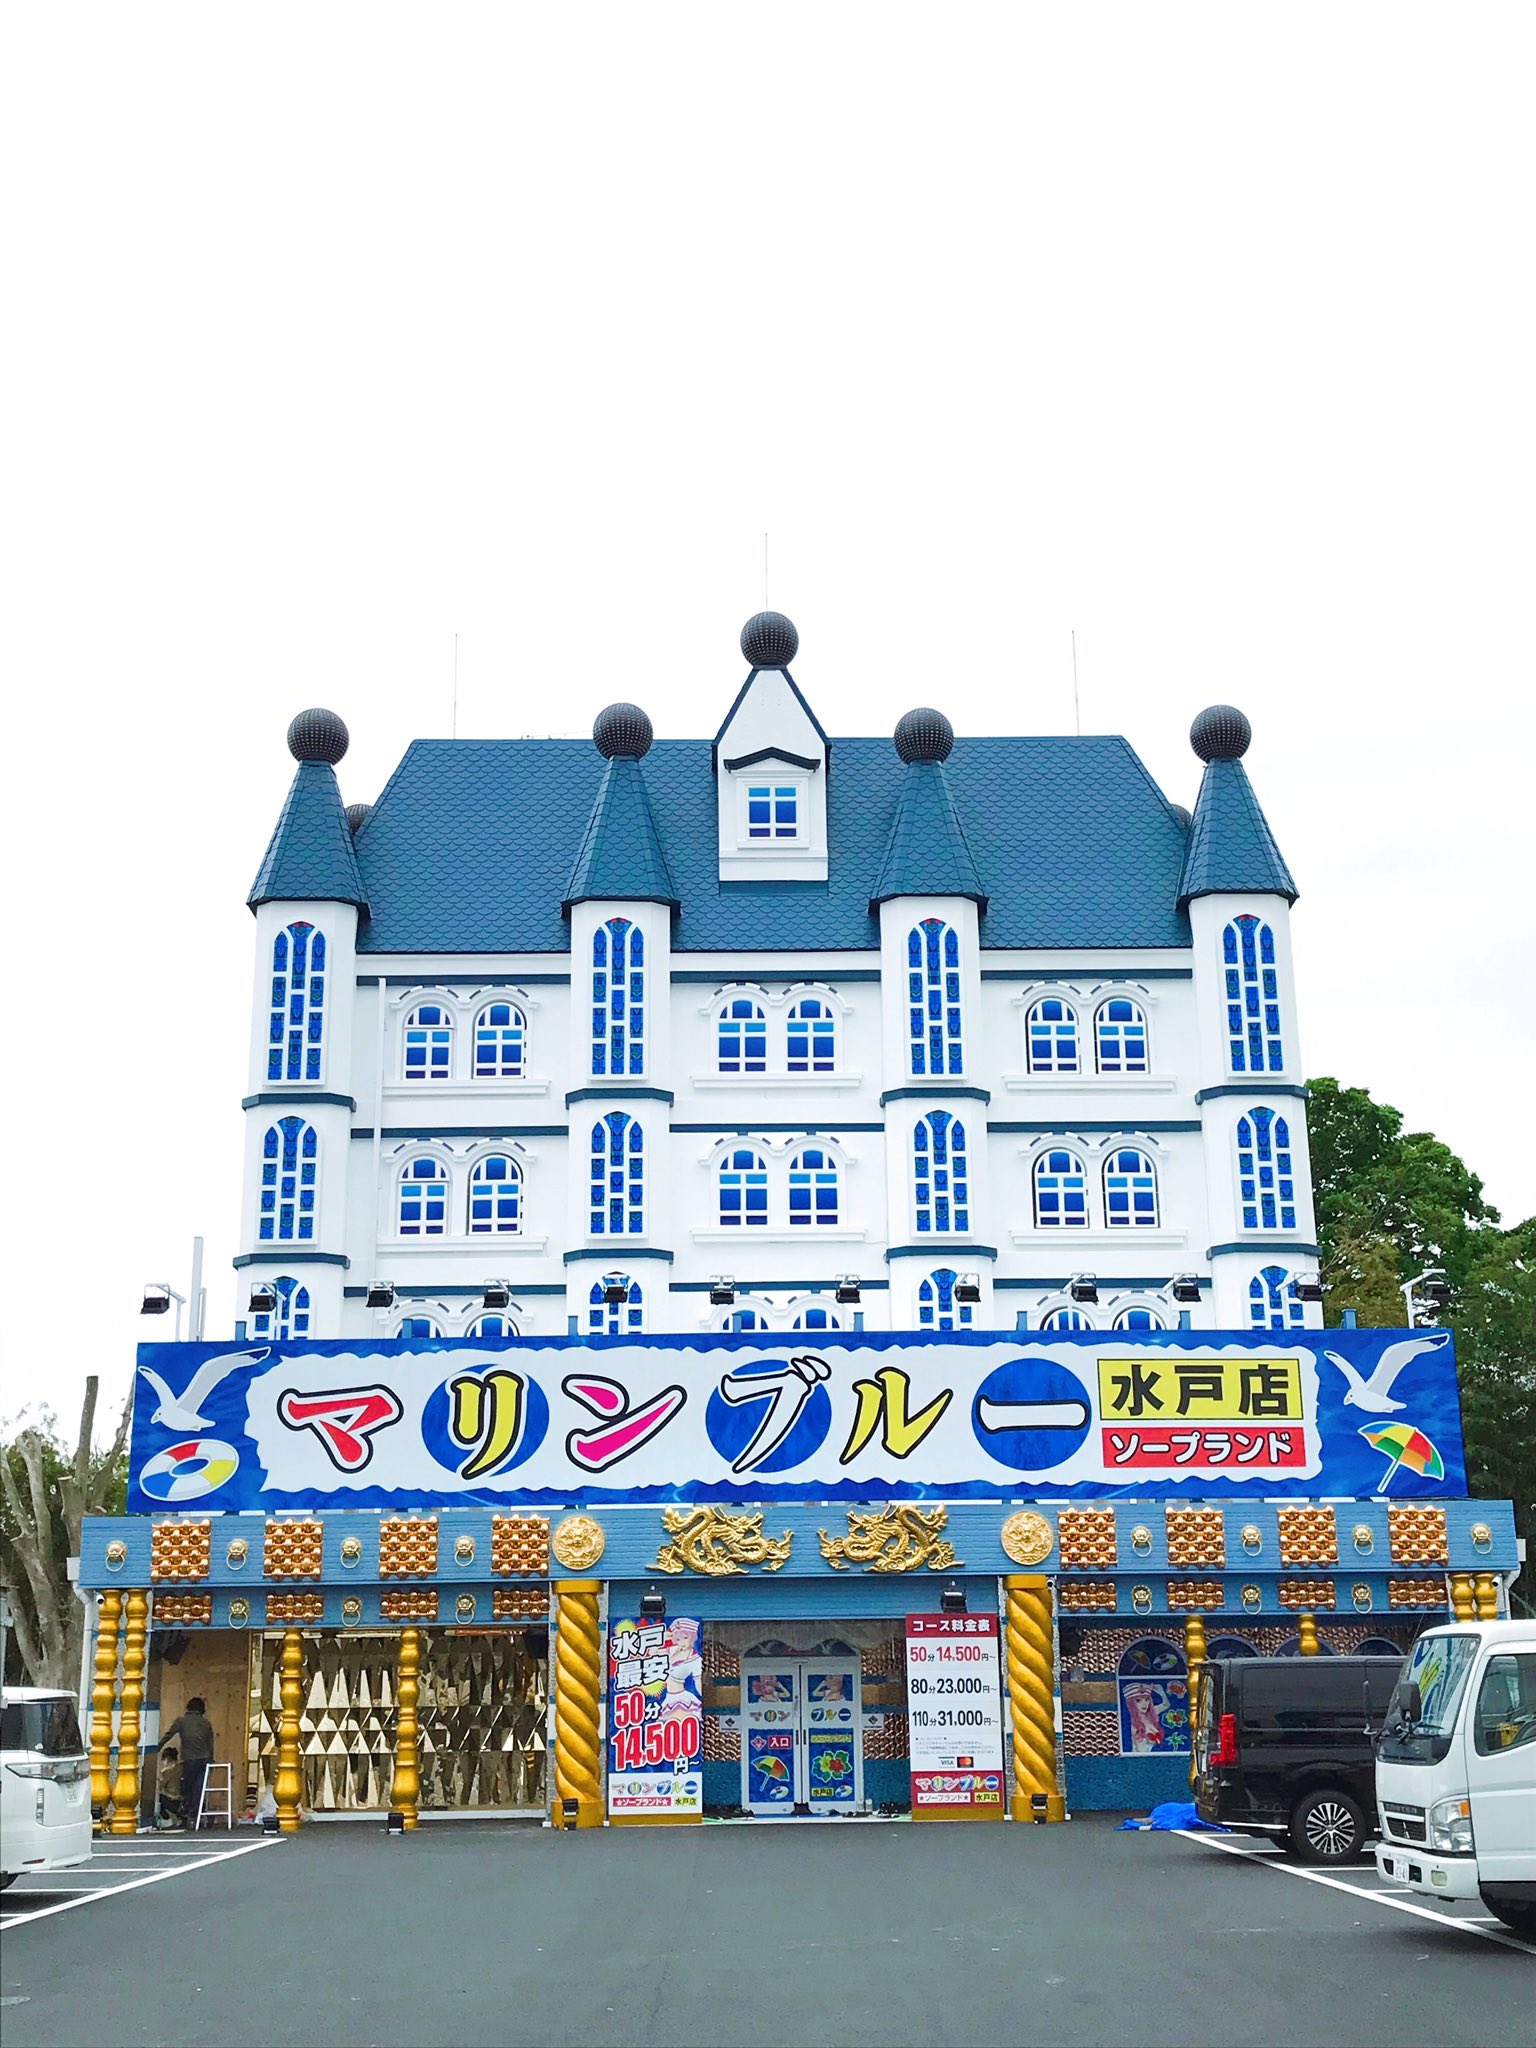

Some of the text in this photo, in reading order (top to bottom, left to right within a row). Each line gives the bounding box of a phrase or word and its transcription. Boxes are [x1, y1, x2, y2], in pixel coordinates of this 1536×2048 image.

[1111, 1364, 1289, 1416] 水戸店
[278, 1355, 1090, 1479] マリンブルー
[1110, 1431, 1292, 1464] ソープランド
[912, 1619, 991, 1632] コース料金表
[611, 1624, 665, 1660] 水戸
[615, 1655, 669, 1690] 最安
[615, 1690, 662, 1729] 50分
[770, 1737, 789, 1747] 入口
[612, 1780, 698, 1796] マリンブルー
[915, 1775, 999, 1792] マリンブルー
[675, 1797, 697, 1806] 水戸店
[975, 1793, 999, 1802] 水戸店
